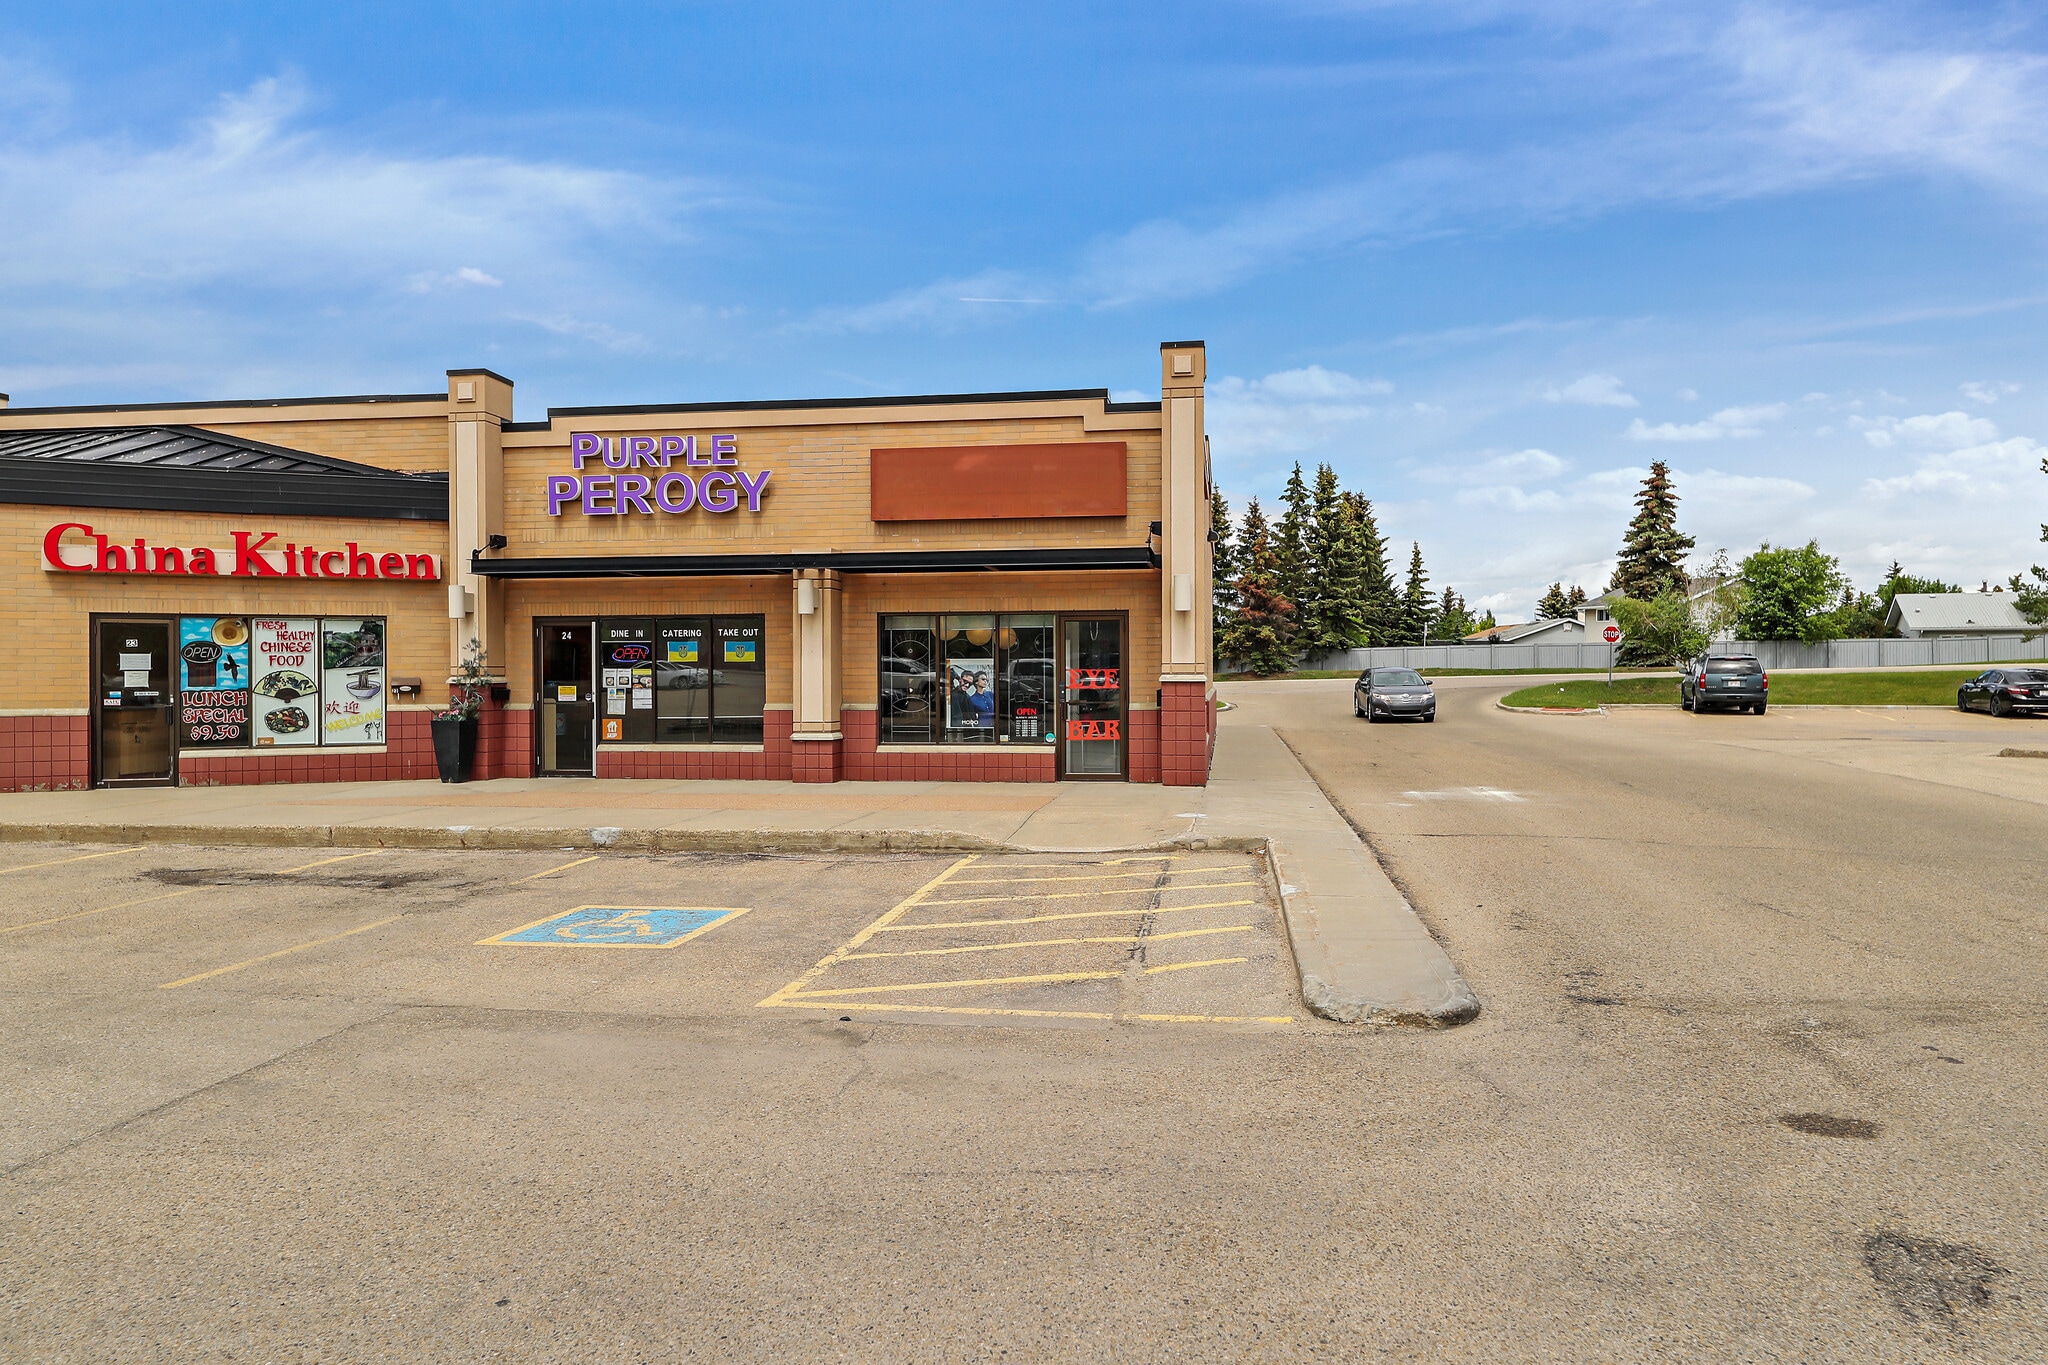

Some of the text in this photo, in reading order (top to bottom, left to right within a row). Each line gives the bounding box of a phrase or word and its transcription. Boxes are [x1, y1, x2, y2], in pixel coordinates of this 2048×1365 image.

[571, 433, 738, 470] PURPLE
[547, 470, 773, 516] PEROGY
[43, 522, 437, 580] China Kitchen
[256, 620, 287, 631] FRESH
[276, 630, 315, 641] HEALTHY
[561, 631, 572, 640] 24
[610, 629, 644, 638] DINE IN
[662, 629, 702, 637] CATERING
[718, 628, 759, 637] TAKE OUT
[1603, 630, 1620, 639] STOP
[183, 646, 219, 659] OPEN
[260, 641, 312, 654] CHINESE
[614, 647, 648, 660] OPEN
[269, 654, 305, 667] FOOD
[1069, 668, 1120, 689] EYE
[182, 690, 248, 707] LUNCH
[325, 700, 361, 715] 欢迎
[1016, 707, 1038, 716] OPEN
[183, 707, 249, 724] SPECIAL
[326, 707, 384, 733] WELCOME
[190, 724, 240, 741] $9.50
[1068, 720, 1121, 740] BAR
